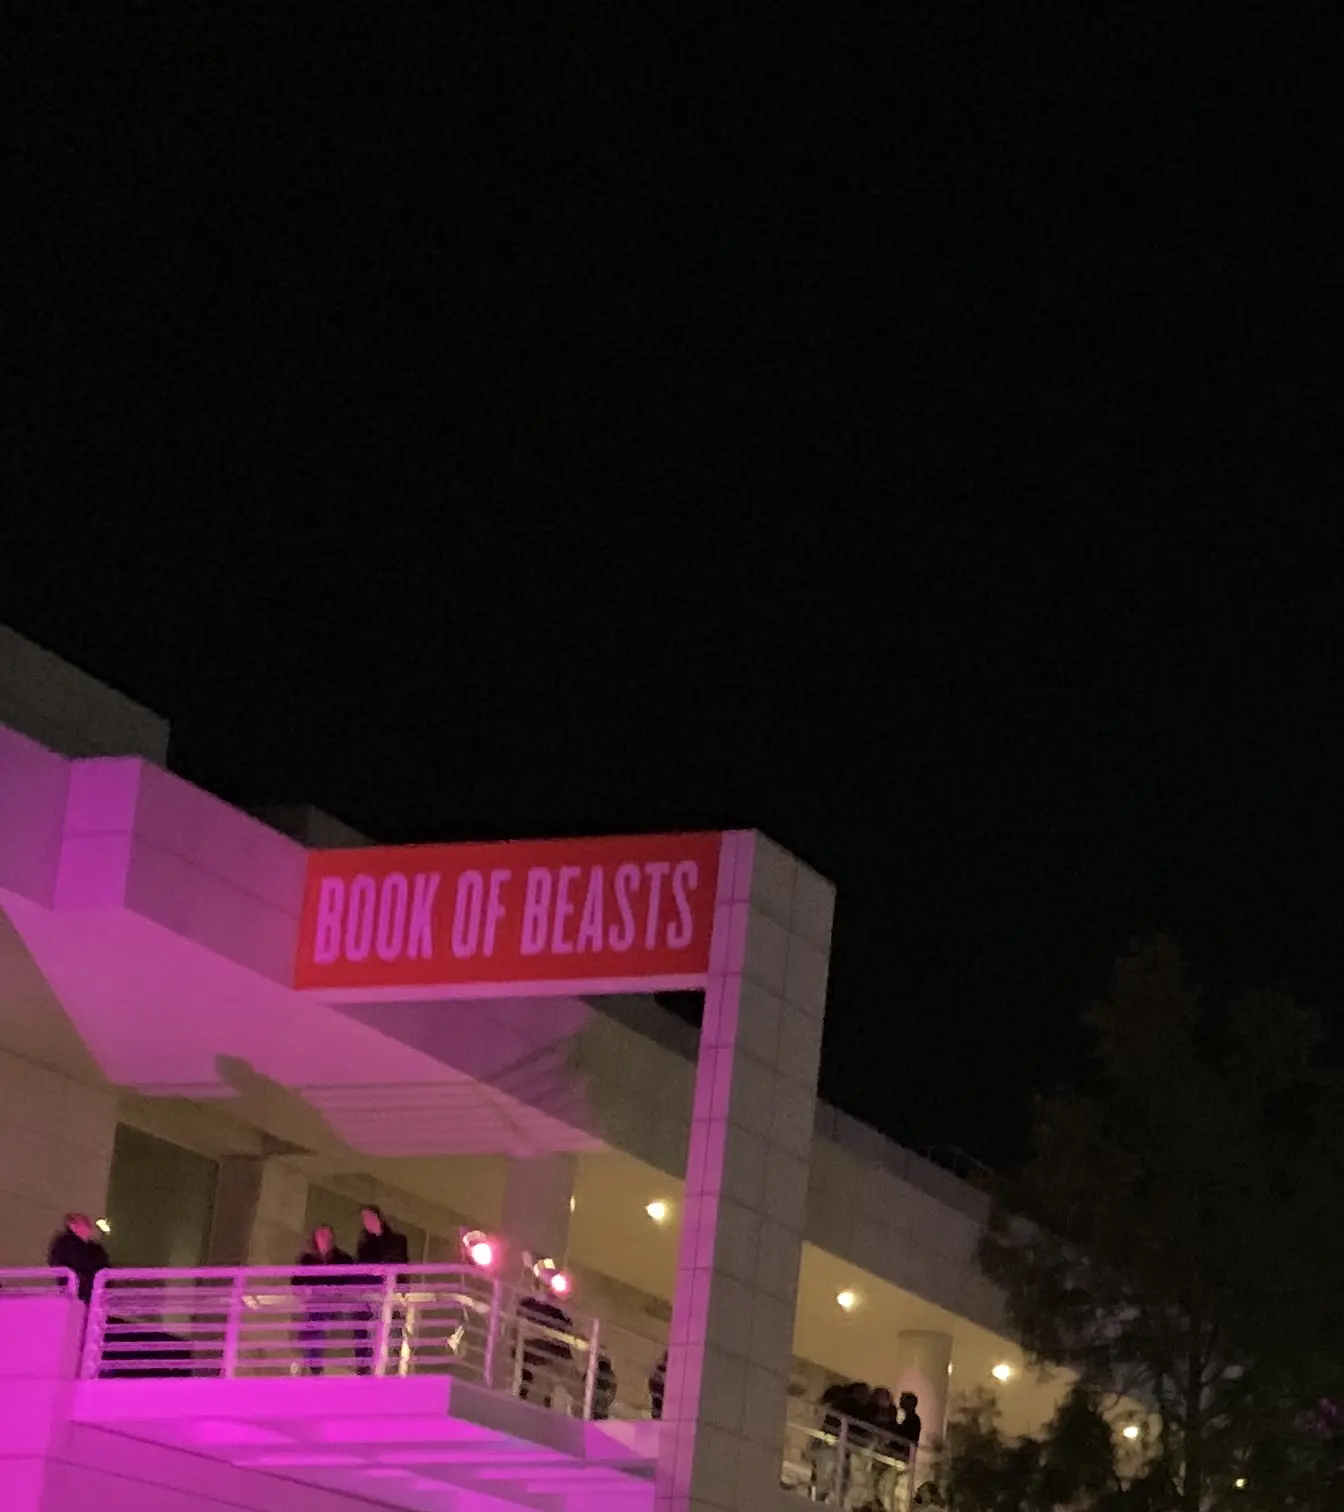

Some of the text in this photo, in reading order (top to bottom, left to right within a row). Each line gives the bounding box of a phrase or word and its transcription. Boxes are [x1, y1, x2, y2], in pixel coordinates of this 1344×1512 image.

[313, 860, 698, 964] BOOK OF BEASTS
